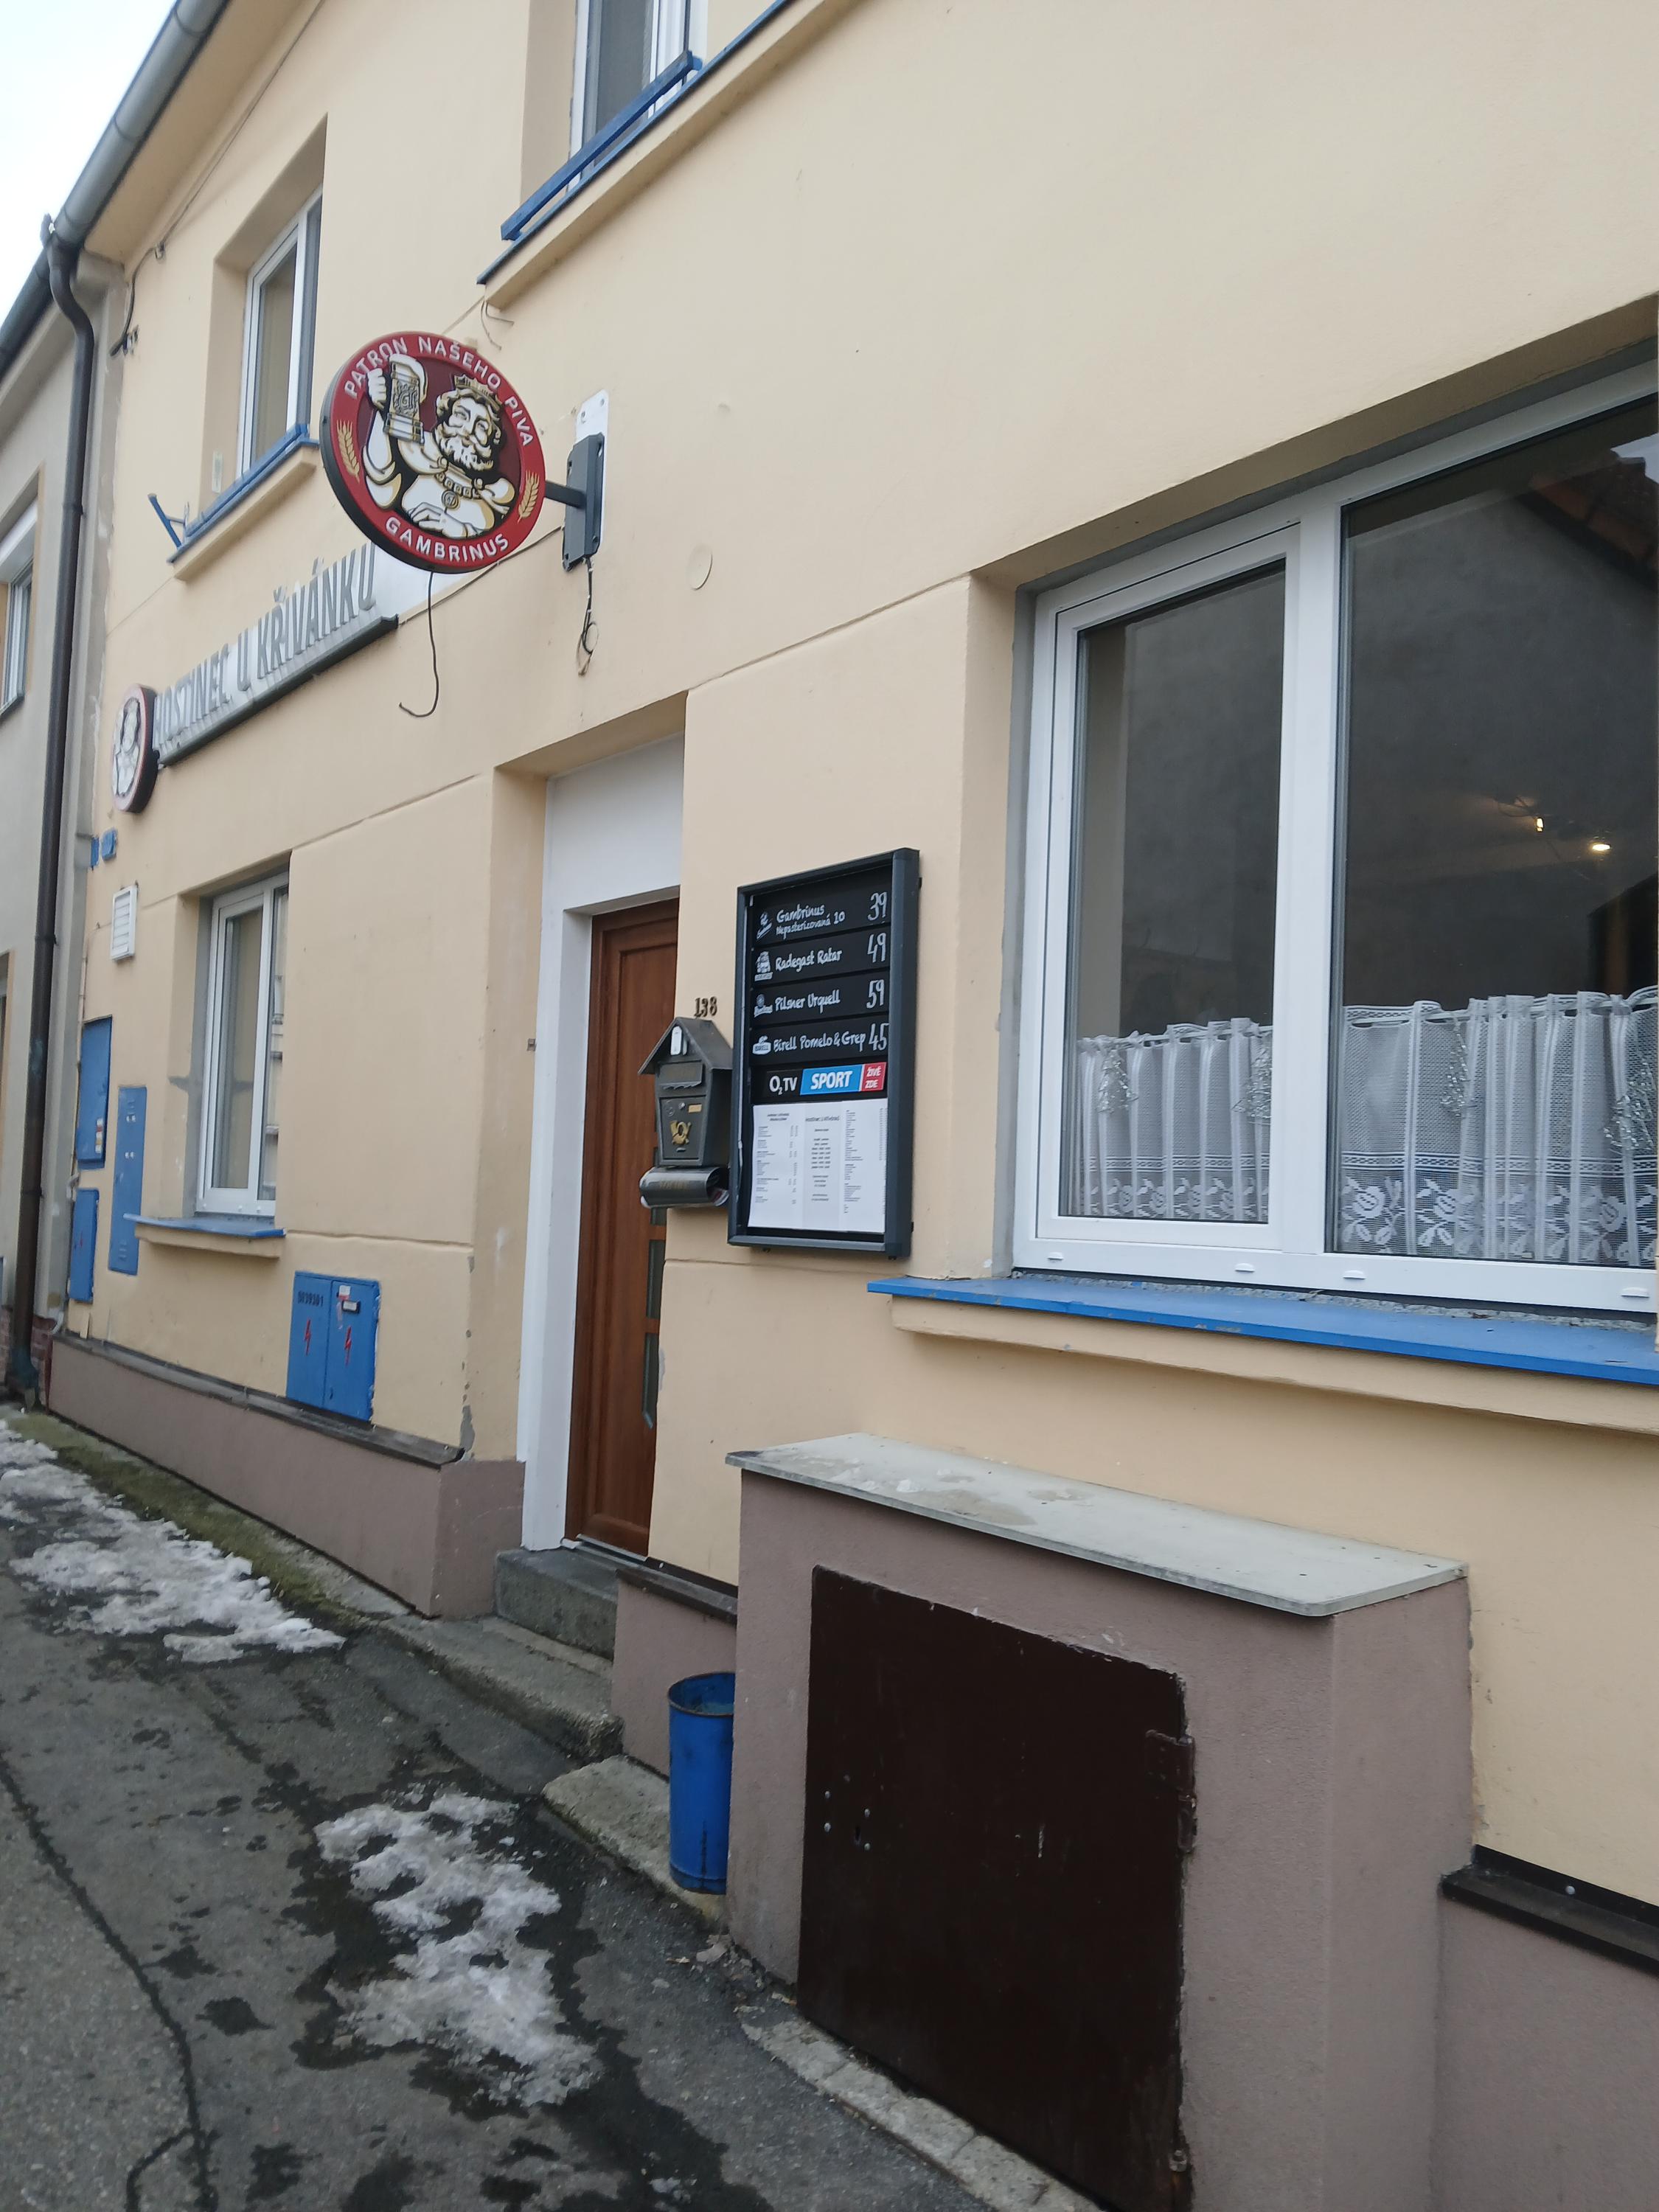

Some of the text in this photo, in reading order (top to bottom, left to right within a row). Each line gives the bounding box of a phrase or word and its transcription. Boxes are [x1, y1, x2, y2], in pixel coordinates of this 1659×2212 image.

[344, 335, 534, 448] PATRON NAŠEHO PIVA
[385, 516, 509, 563] GAMBRINUS
[236, 627, 251, 692] U
[776, 904, 825, 923] Gambrinus
[834, 911, 846, 925] 10
[867, 891, 887, 921] 39
[775, 950, 815, 973] Radegast
[867, 932, 887, 963] 49
[693, 995, 718, 1018] 138
[775, 996, 806, 1012] Pilsner
[807, 990, 841, 1014] Urquell
[866, 979, 885, 1009] 59
[773, 1037, 798, 1053] Birell
[868, 1023, 889, 1051] 45
[811, 1071, 853, 1091] SPORT
